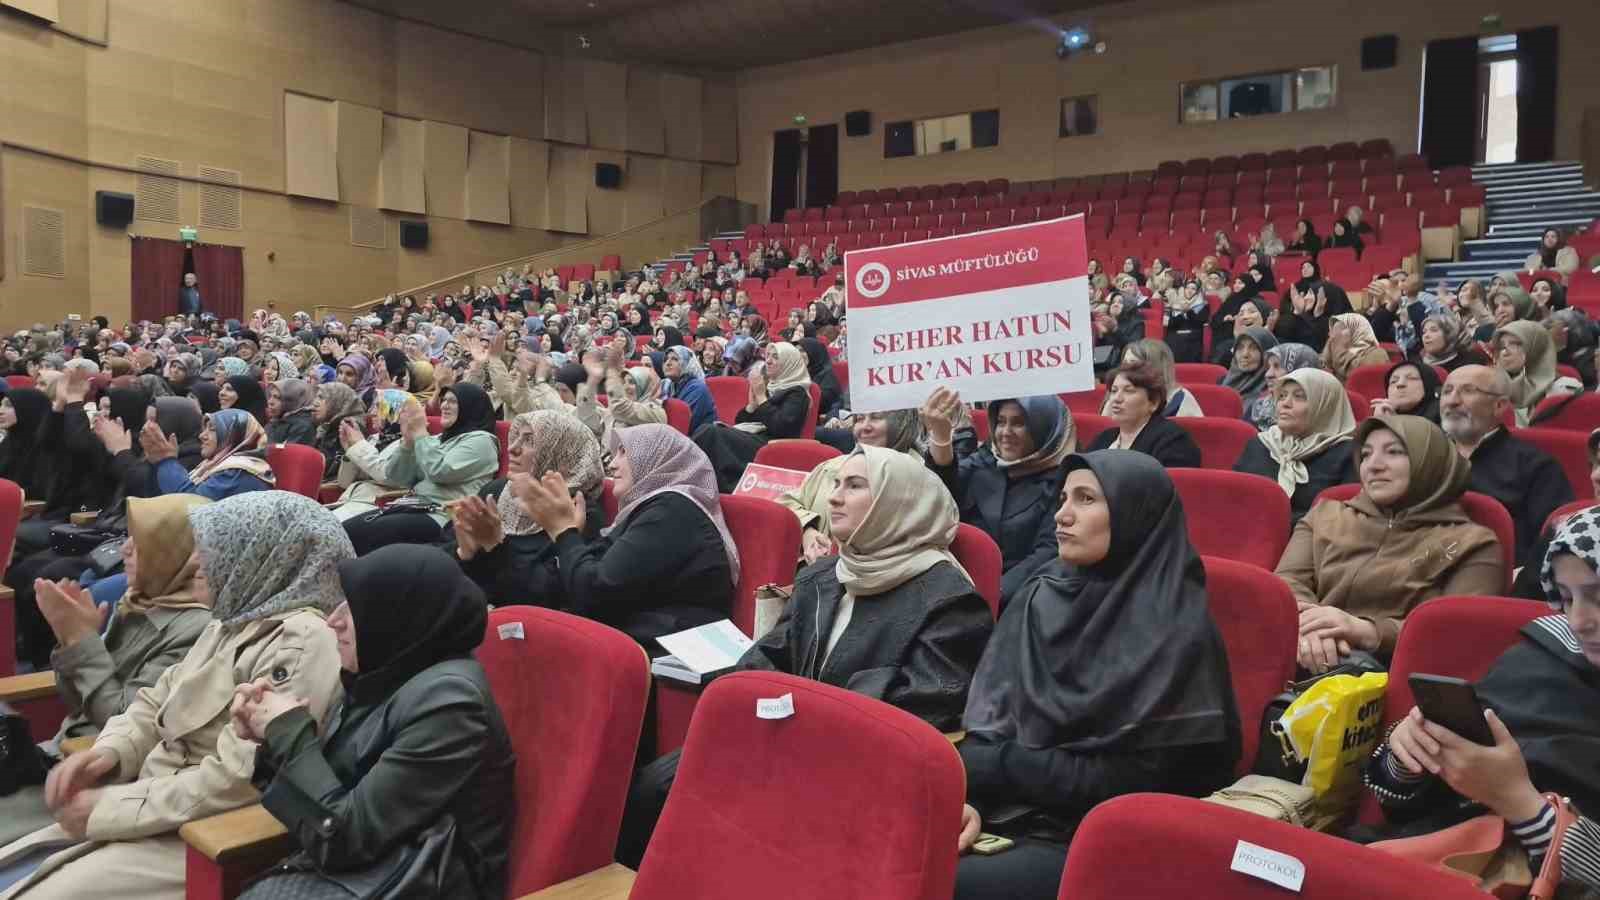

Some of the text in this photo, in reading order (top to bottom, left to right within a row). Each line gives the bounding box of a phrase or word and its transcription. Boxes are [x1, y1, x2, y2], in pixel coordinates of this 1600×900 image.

[896, 247, 1039, 281] SİVAS MÜFTÜLÜĞÜ
[872, 310, 1072, 355] SEHER HATUN
[867, 343, 1082, 387] KUR'AN KURSU
[1238, 852, 1298, 880] PROTOKOL
